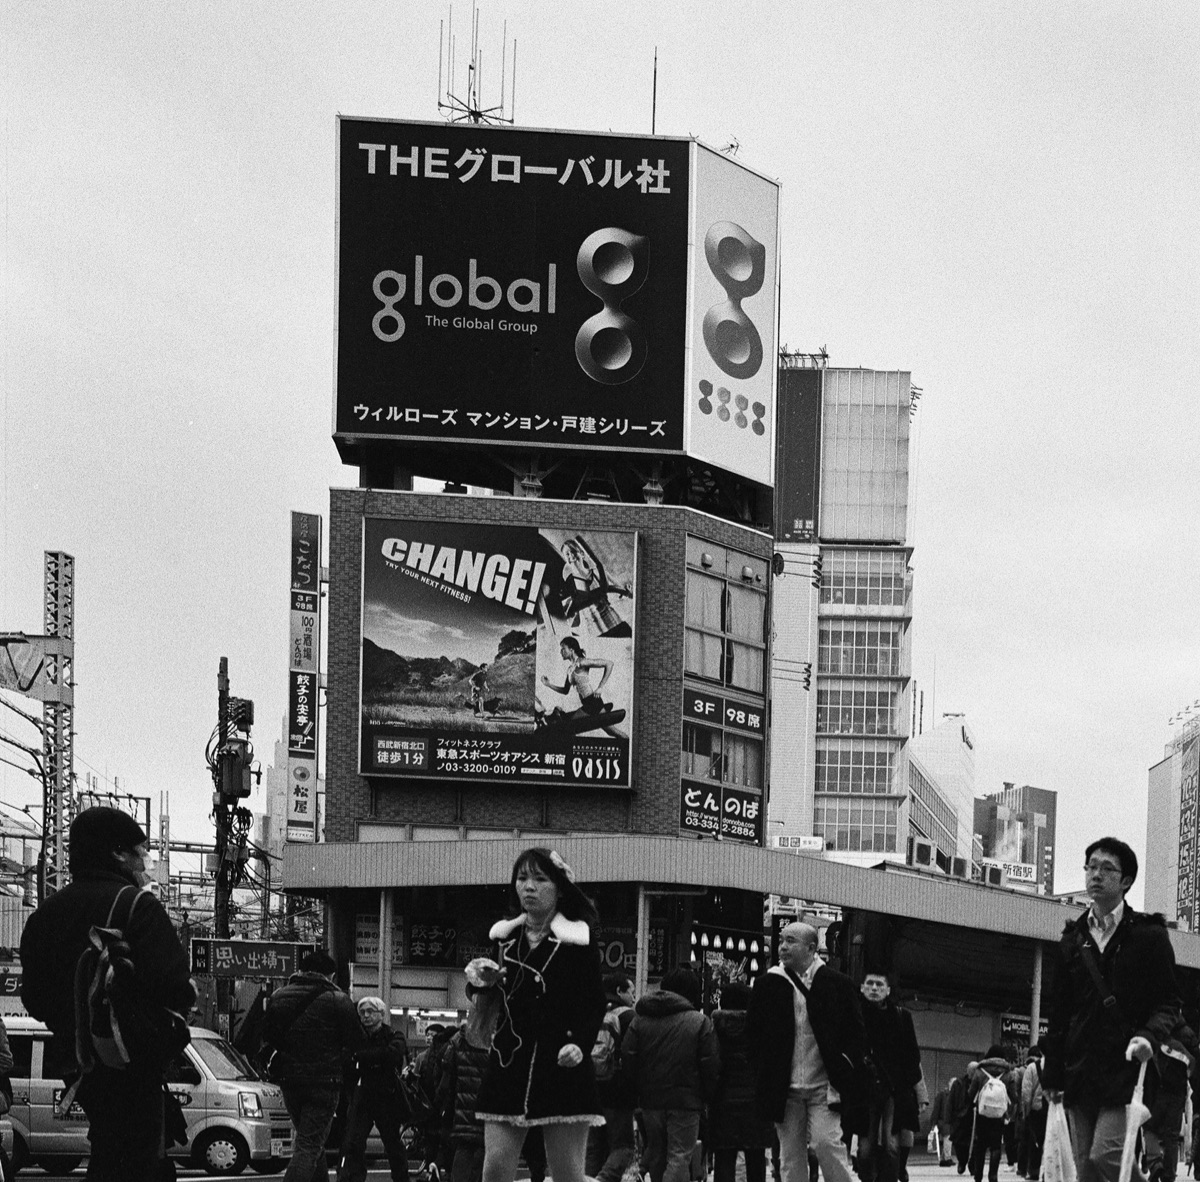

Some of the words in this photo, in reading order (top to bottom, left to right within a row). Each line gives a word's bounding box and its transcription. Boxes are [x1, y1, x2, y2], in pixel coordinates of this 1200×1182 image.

[358, 142, 671, 194] THEグローバル社
[372, 254, 557, 342] global
[425, 315, 449, 328] The
[453, 316, 494, 331] Global
[498, 319, 538, 335] Group
[353, 404, 458, 426] ウィルローズ
[466, 411, 667, 437] マンション・戸建シリーズ
[381, 537, 547, 615] CHANGE!
[385, 560, 398, 570] TRY
[401, 568, 420, 580] YOUR
[420, 576, 440, 589] NEXT
[440, 584, 472, 604] FITNESS!
[694, 699, 716, 715] 3F
[726, 708, 761, 729] 98席
[377, 739, 425, 751] 西武新宿北口
[436, 748, 540, 763] 東急スポーツオアシス
[544, 753, 566, 765] 新宿
[437, 738, 501, 749] フィットネスクラブ
[377, 751, 424, 766] 徒歩1分
[445, 762, 517, 775] 03-3200-0109
[293, 784, 310, 814] 松屋
[684, 788, 759, 820] どんのば
[685, 816, 755, 838] 03-3342-2886
[215, 946, 291, 973] 思い出横丁
